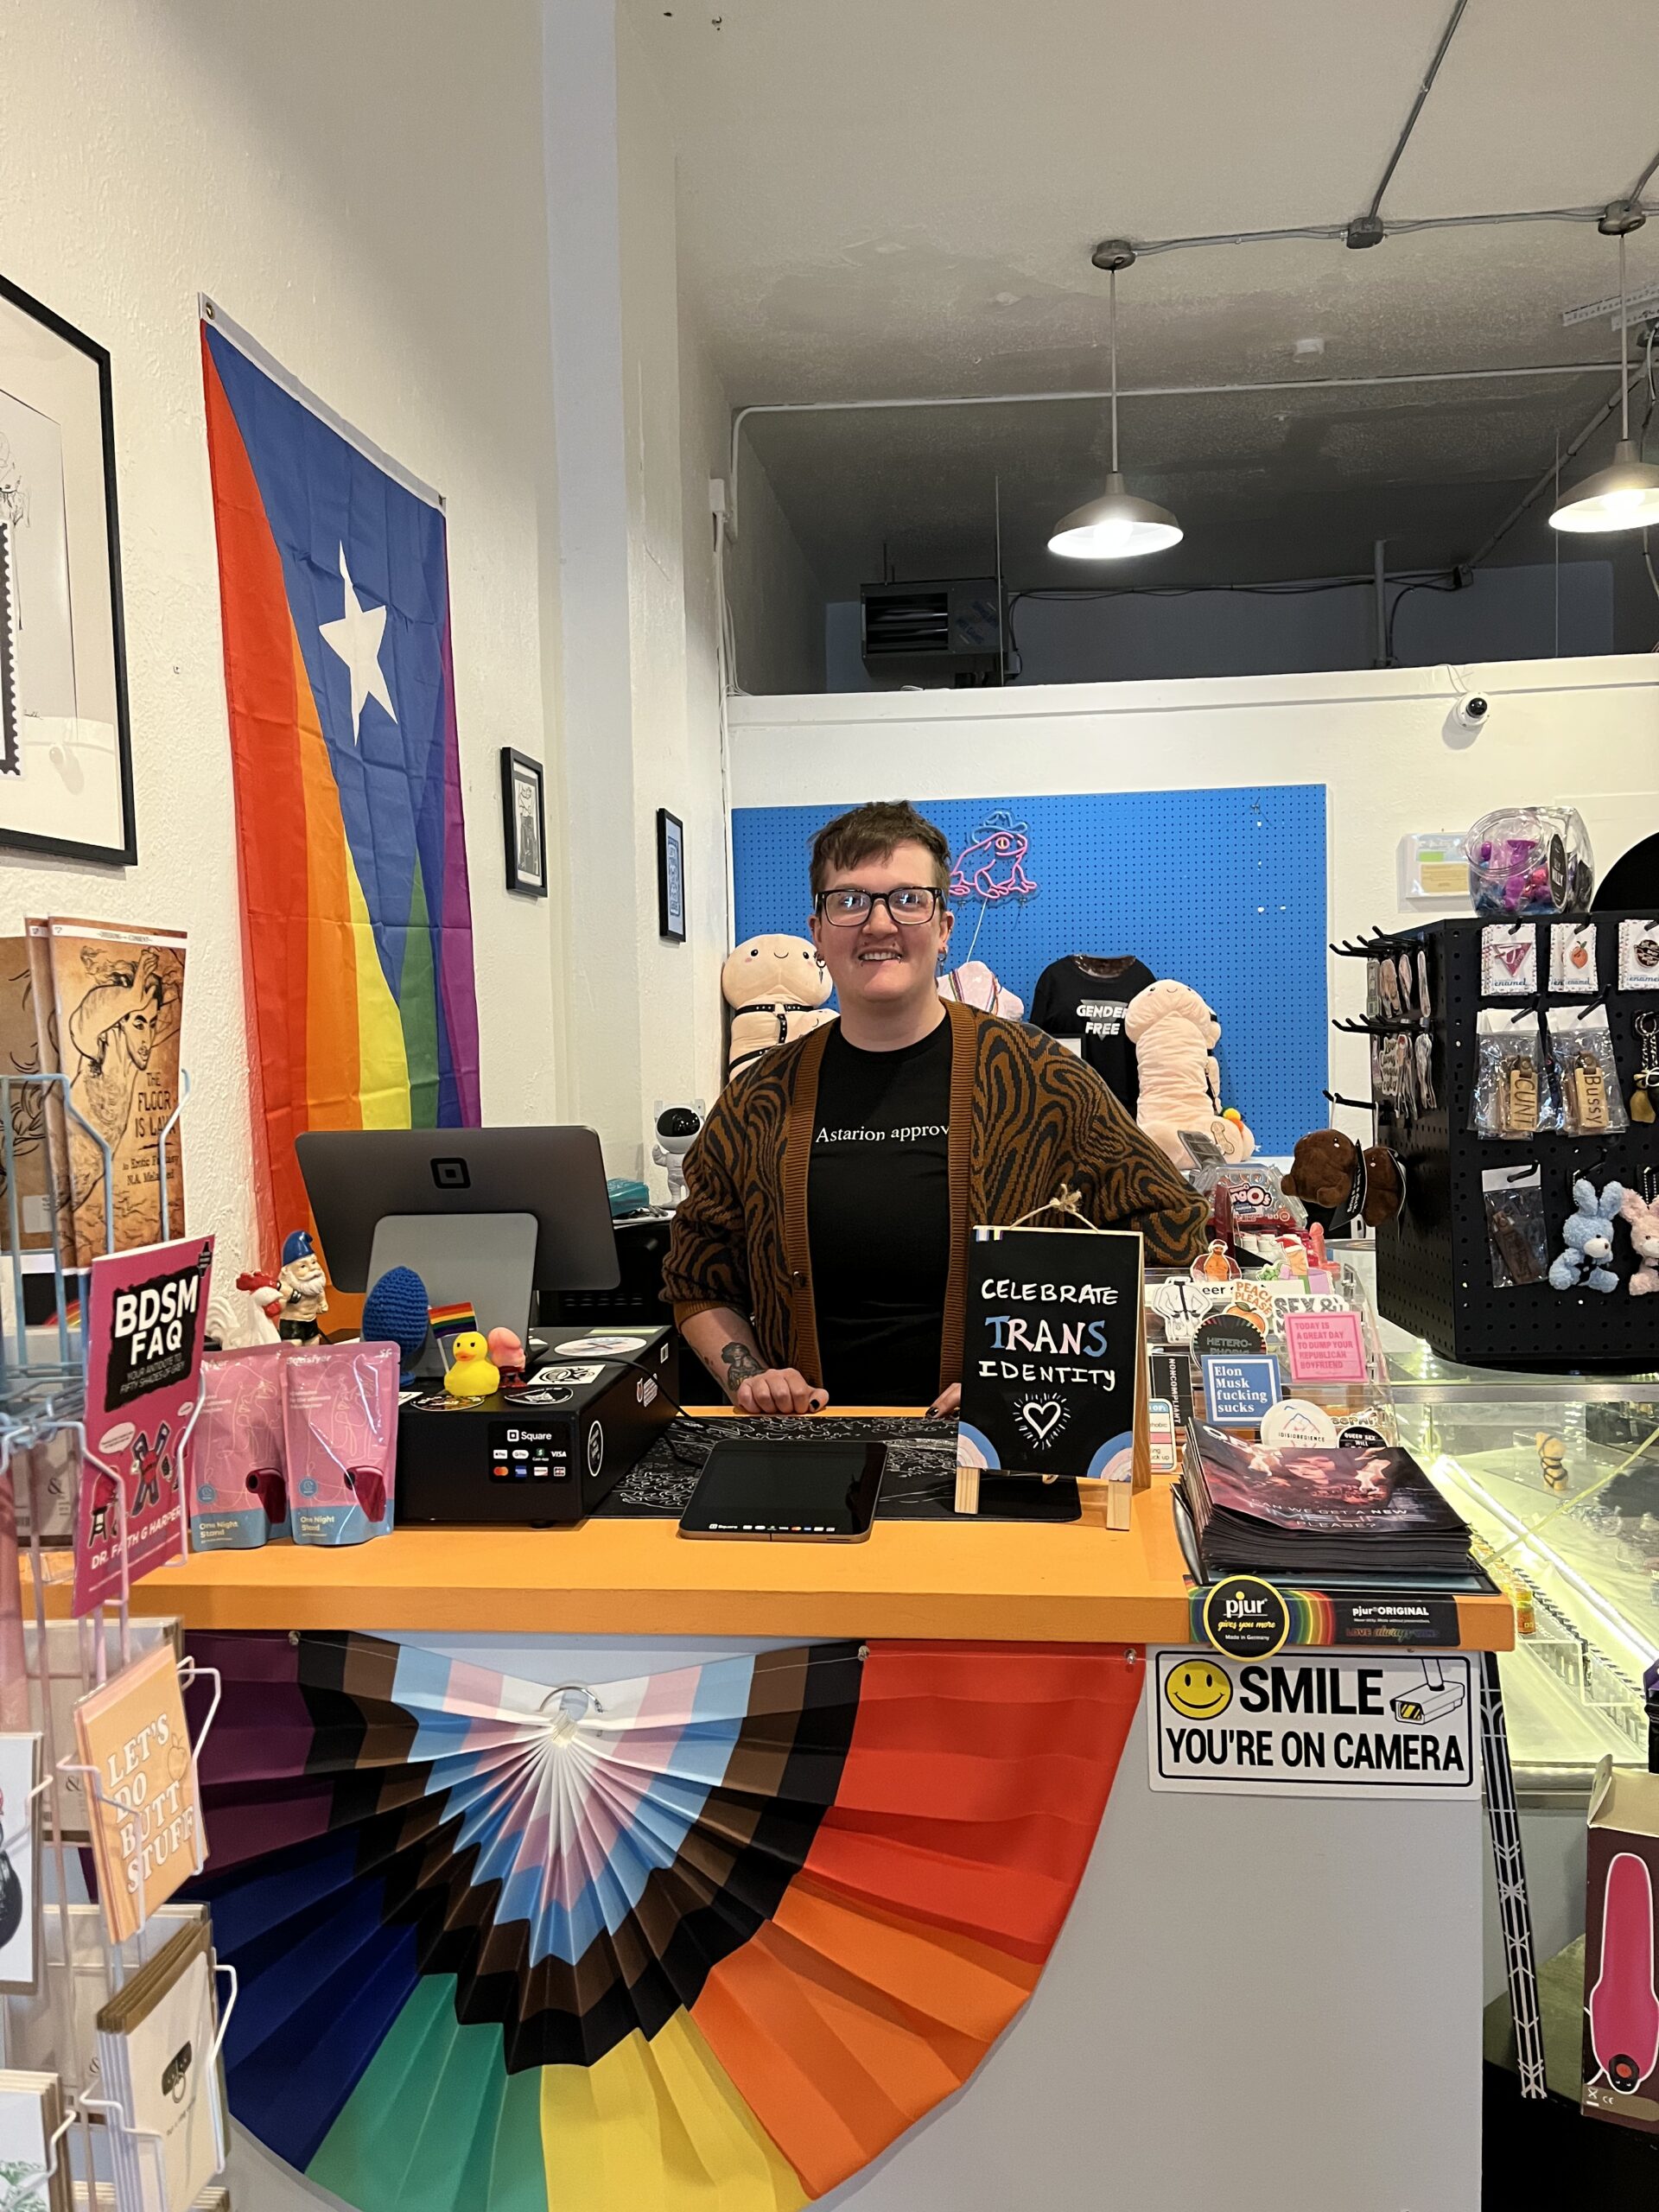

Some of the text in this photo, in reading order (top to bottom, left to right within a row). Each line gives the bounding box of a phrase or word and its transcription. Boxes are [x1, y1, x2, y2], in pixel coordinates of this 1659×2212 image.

[1085, 1022, 1121, 1035] FREE
[146, 1071, 162, 1086] THE
[137, 1090, 171, 1111] FLOOR
[1514, 1078, 1536, 1128] CUNT
[135, 1117, 145, 1138] IS
[816, 1125, 950, 1142] Astarion approv
[981, 1278, 1119, 1306] CELEBRATE
[114, 1274, 199, 1338] BDSM
[1235, 1292, 1273, 1315] PLEASE
[130, 1319, 183, 1365] FAQ
[984, 1315, 1109, 1358] TRANS
[1206, 1337, 1252, 1348] HETERO-
[1299, 1351, 1347, 1359] REPUBLICAN
[978, 1360, 1116, 1392] IDENTITY
[1214, 1366, 1243, 1376] Elon
[1168, 1357, 1181, 1424] NONCOMPLIANT
[1216, 1378, 1250, 1389] Musk
[1217, 1389, 1268, 1403] fucking
[1217, 1402, 1255, 1413] sucks
[520, 1431, 552, 1442] Square
[199, 1521, 238, 1530] One Night
[314, 1515, 335, 1524] Night
[91, 1551, 109, 1570] DR.
[111, 1533, 139, 1558] FATH
[140, 1528, 149, 1540] G
[149, 1505, 181, 1535] HARPER
[199, 1529, 225, 1538] Stand
[1217, 1620, 1237, 1631] gives
[1238, 1621, 1255, 1631] you
[1239, 1665, 1384, 1716] SMILE
[107, 1713, 170, 1788] LET'S
[1166, 1726, 1465, 1771] YOU'RE ON CAMERA
[114, 1771, 147, 1824] DO
[119, 1780, 181, 1859] BUTT
[125, 1805, 194, 1894] STUFF
